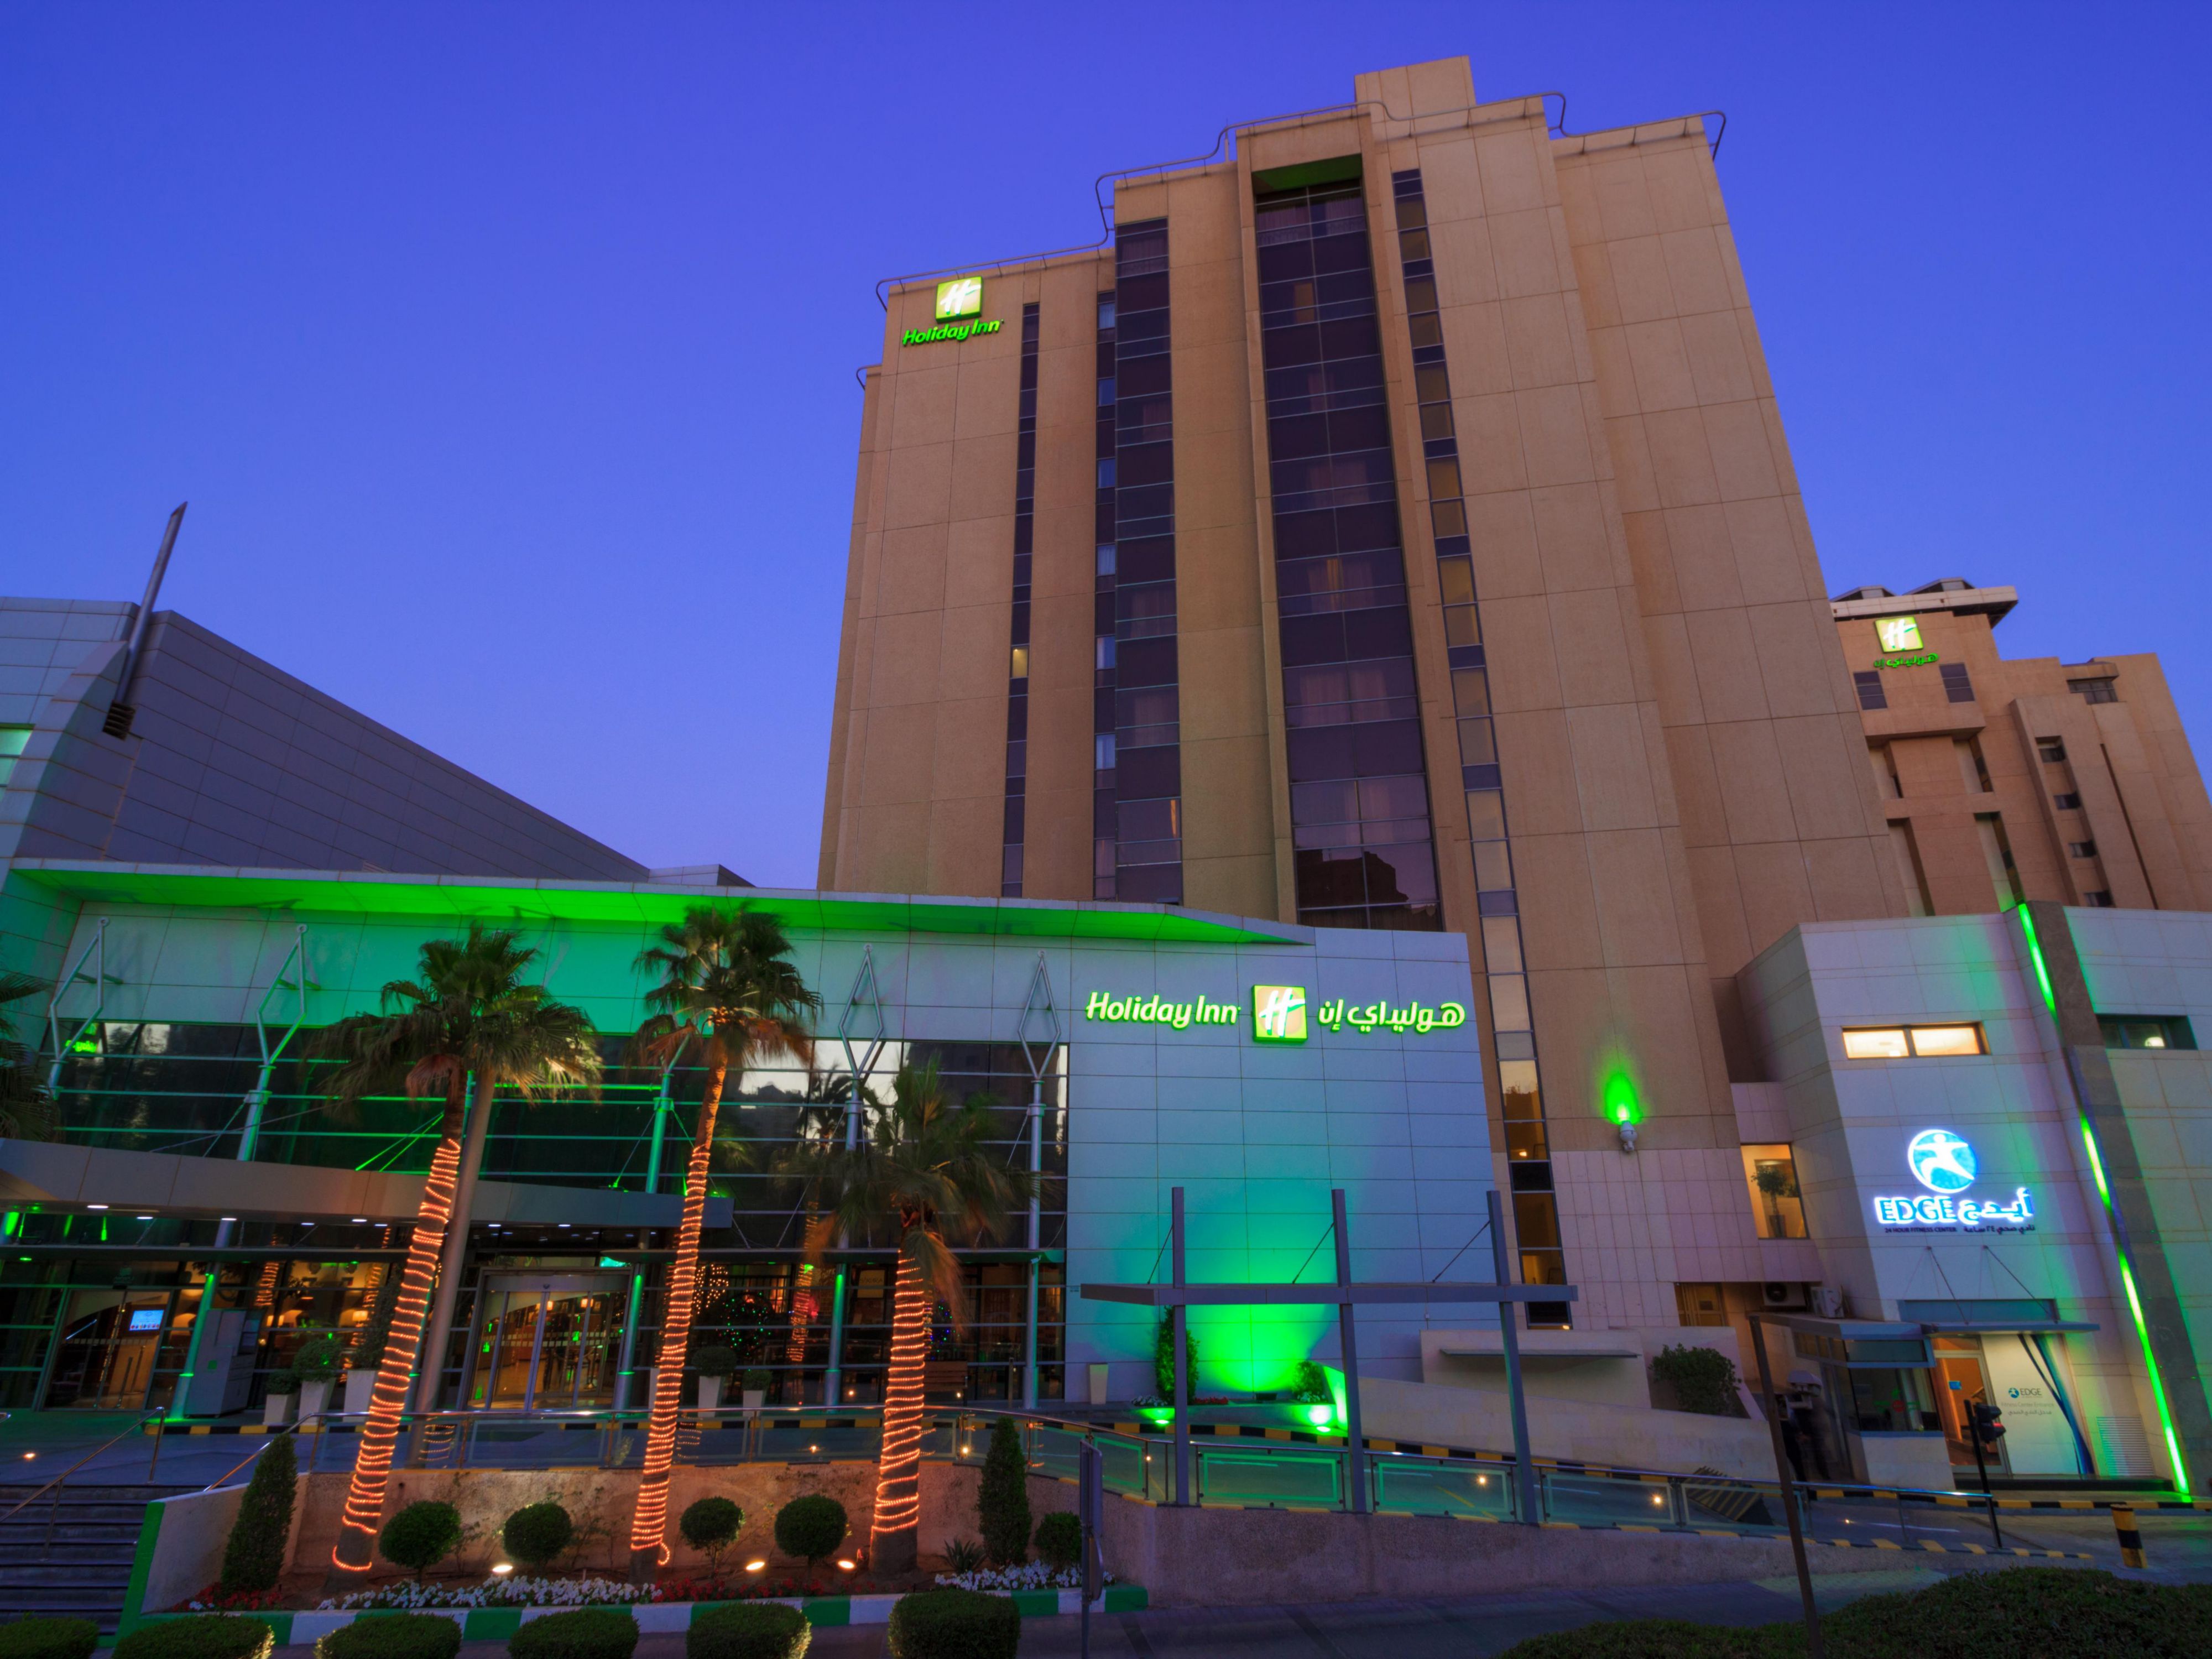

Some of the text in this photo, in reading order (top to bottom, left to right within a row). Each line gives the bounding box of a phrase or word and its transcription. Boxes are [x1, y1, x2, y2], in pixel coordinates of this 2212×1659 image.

[902, 319, 1000, 345] Holiday Inn
[1886, 653, 1938, 668] هوليداي
[1086, 992, 1238, 1029] Holiday Inn
[1318, 999, 1465, 1033] هوليداي إن
[1876, 1196, 1958, 1224] EDGE
[2020, 1387, 2042, 1396] EDGE
